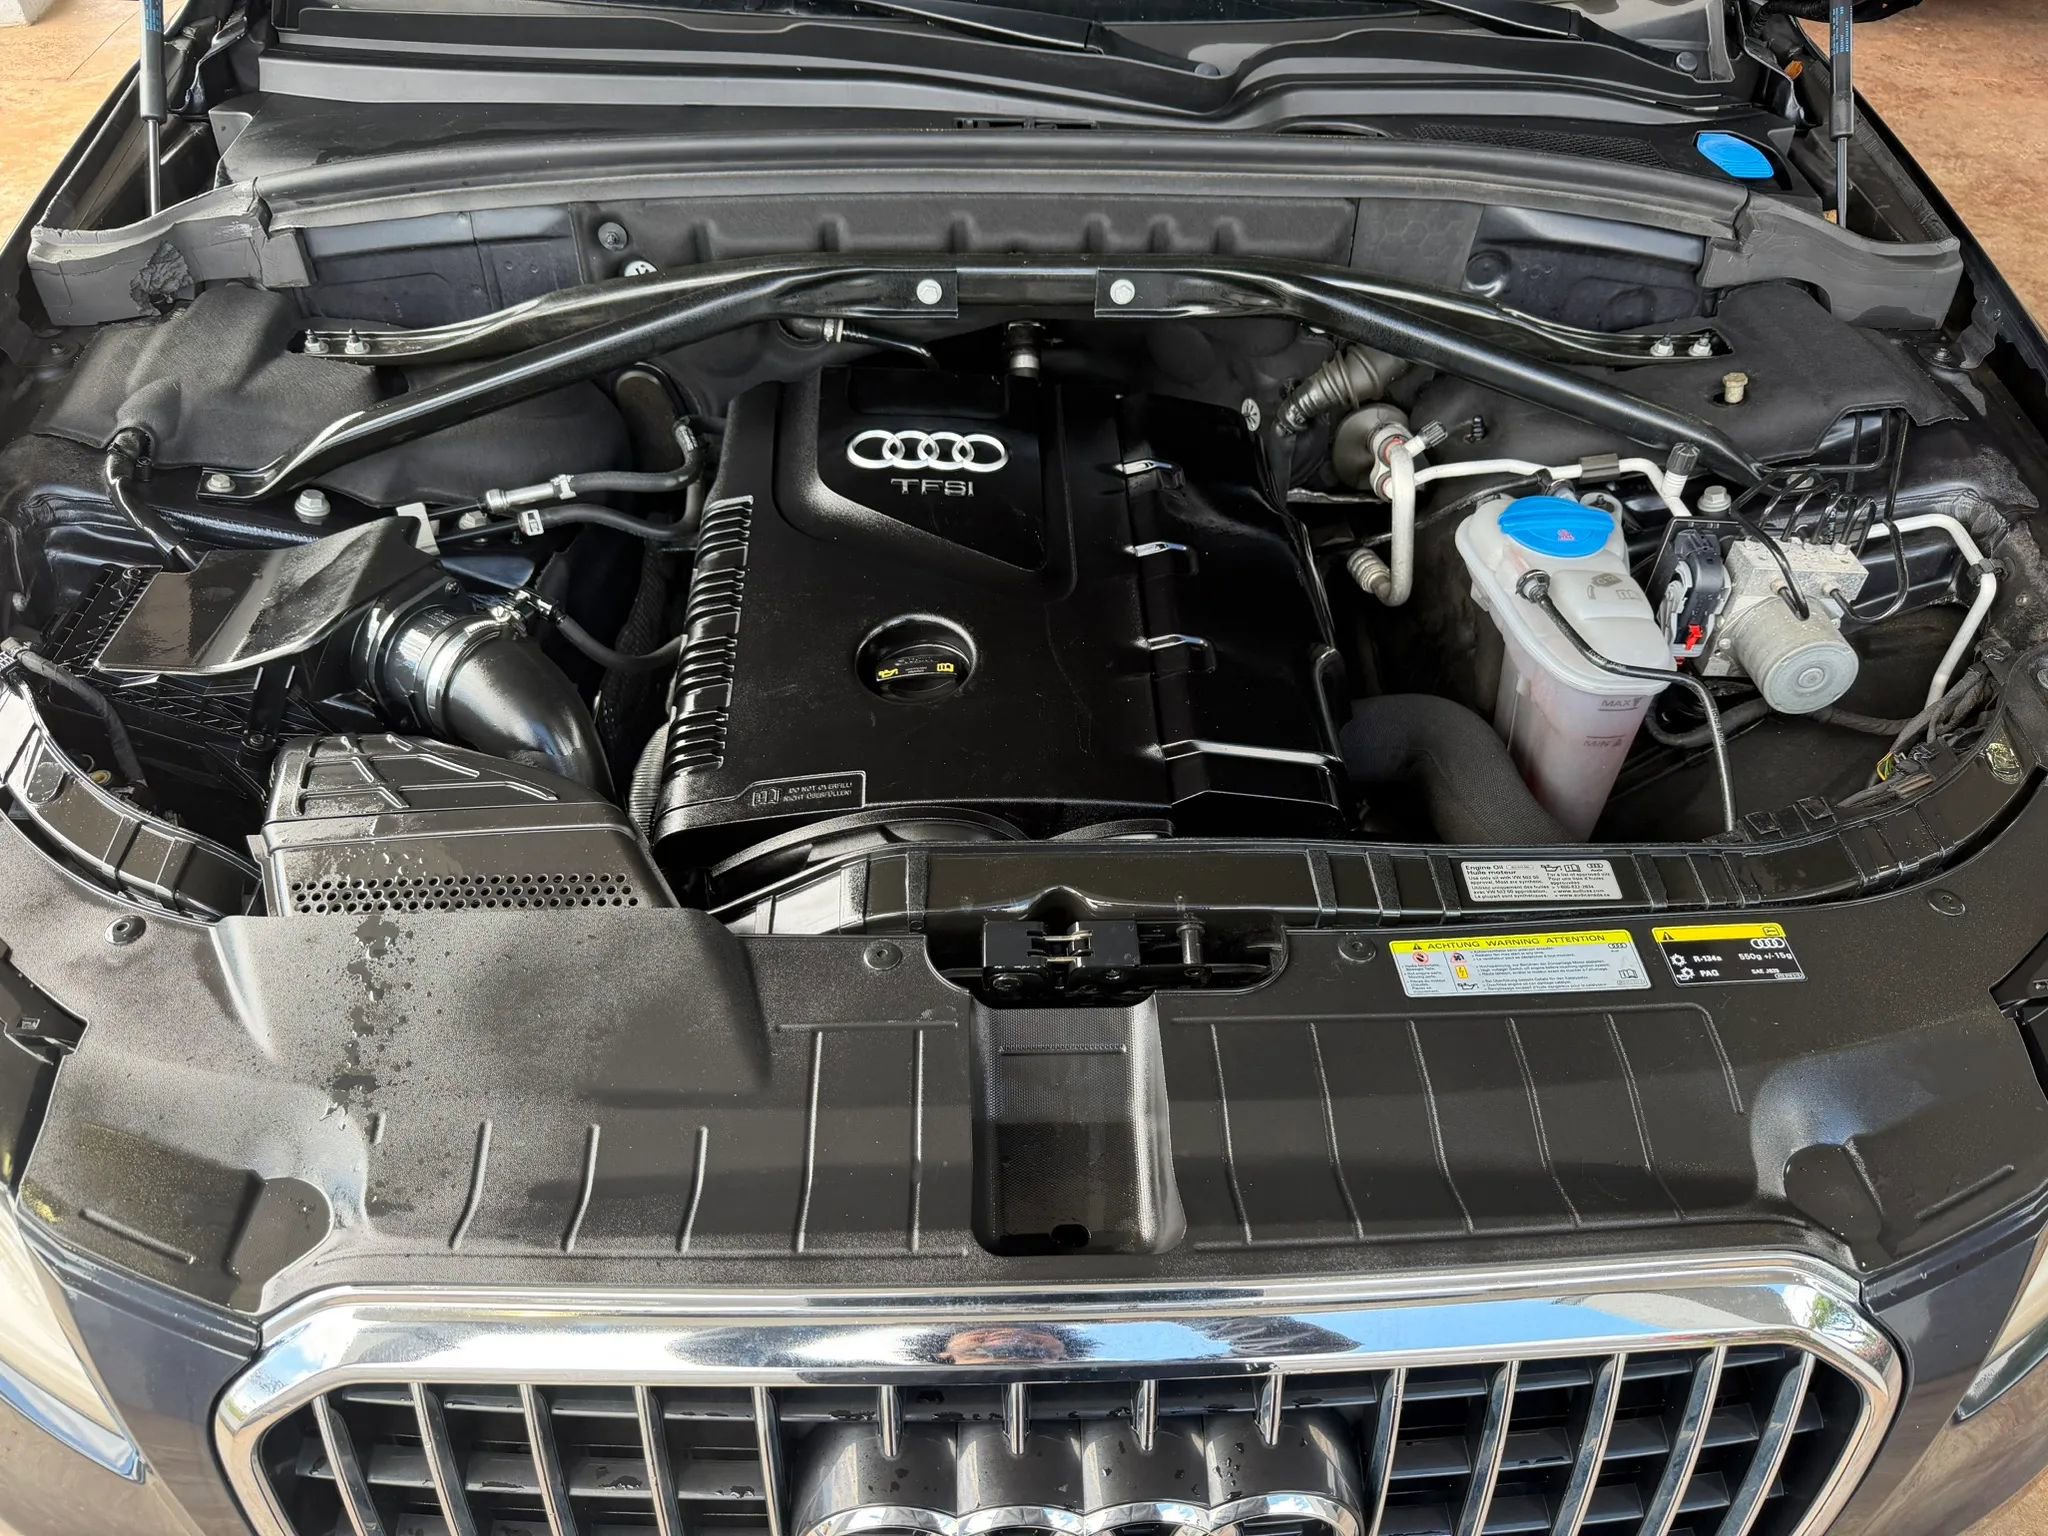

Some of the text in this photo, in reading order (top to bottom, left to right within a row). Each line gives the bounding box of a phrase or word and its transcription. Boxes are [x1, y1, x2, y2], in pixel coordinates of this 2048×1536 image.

[890, 478, 974, 497] TFSI
[1600, 699, 1631, 707] MAX
[1583, 740, 1609, 748] MIN
[1427, 935, 1605, 949] ACHTUNG WARNING ATTENTION
[1692, 955, 1723, 963] R-134a
[1738, 953, 1762, 961] 550g
[1699, 969, 1720, 977] PAG
